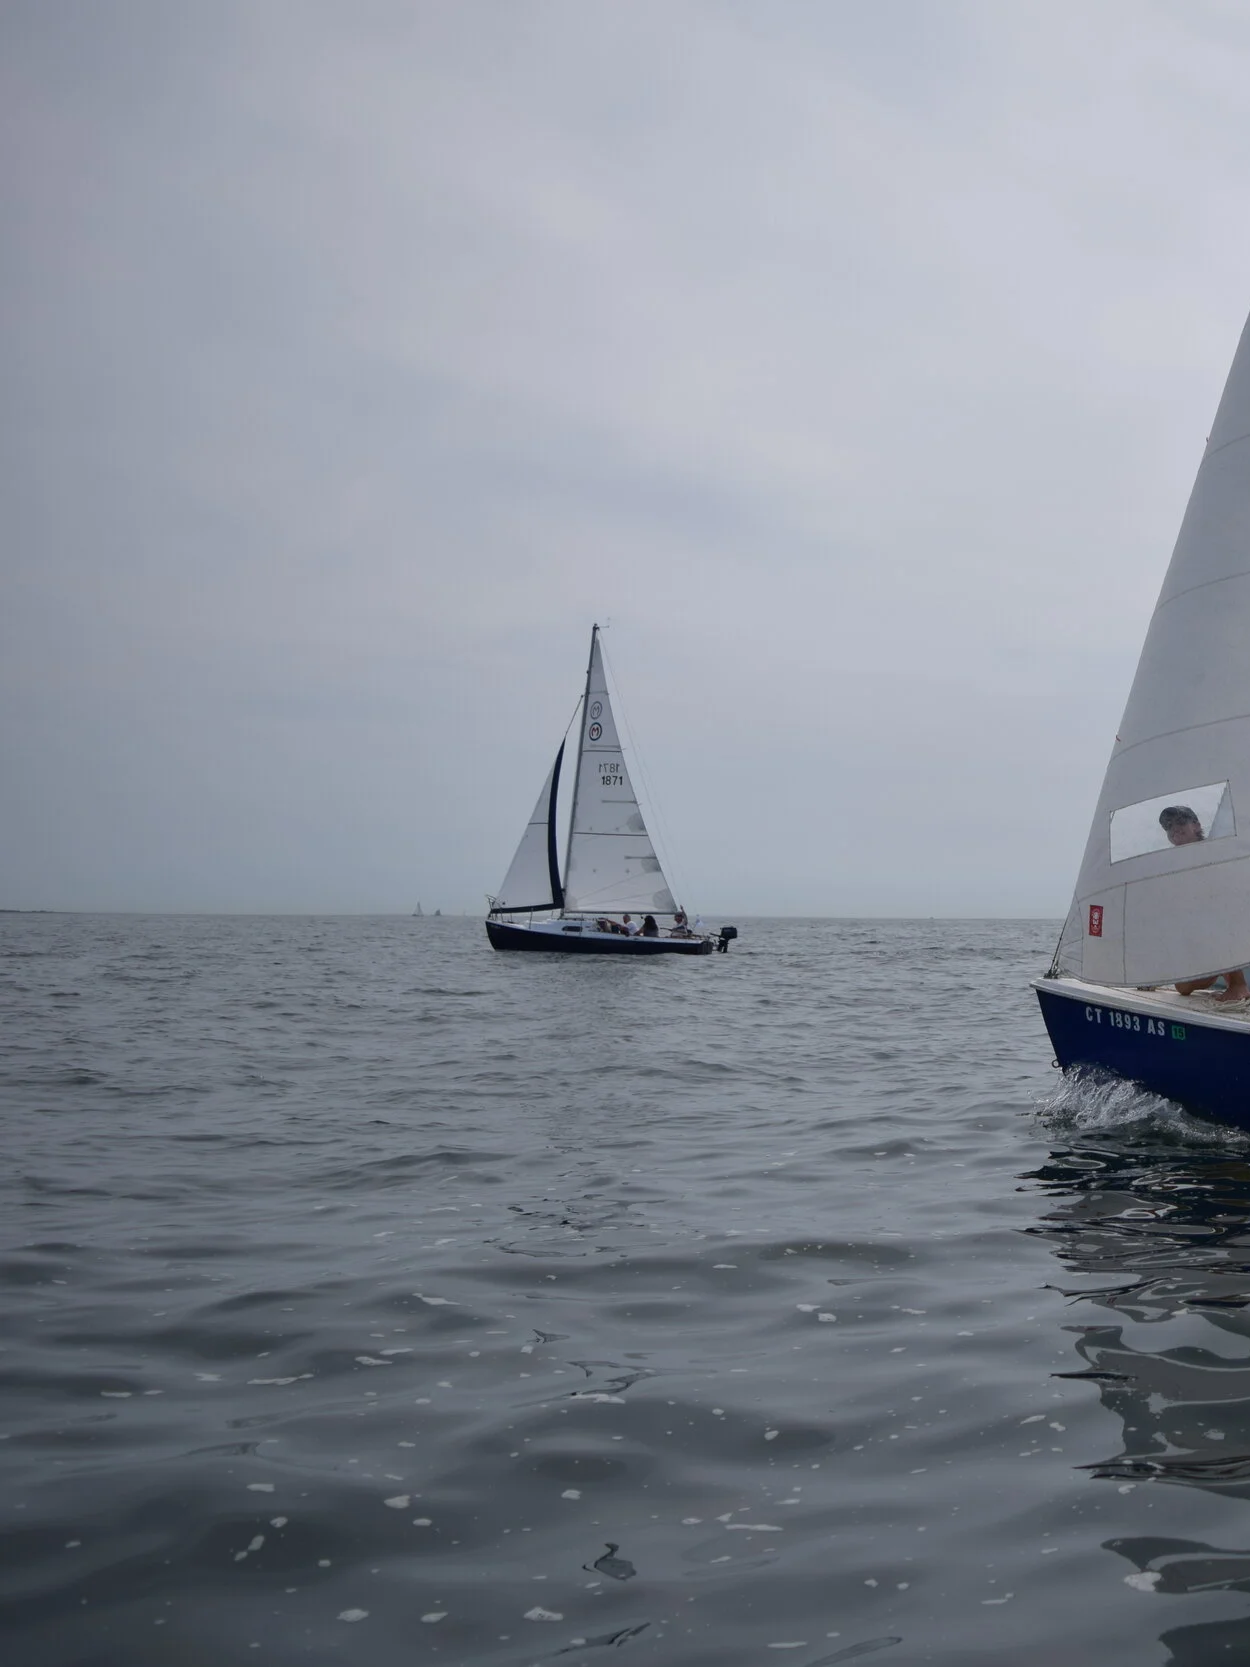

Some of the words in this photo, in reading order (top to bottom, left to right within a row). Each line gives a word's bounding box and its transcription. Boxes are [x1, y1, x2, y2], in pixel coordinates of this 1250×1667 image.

[601, 775, 623, 786] 1871
[1085, 1006, 1102, 1023] CT
[1108, 1012, 1141, 1032] 1893
[1147, 1019, 1166, 1036] AS
